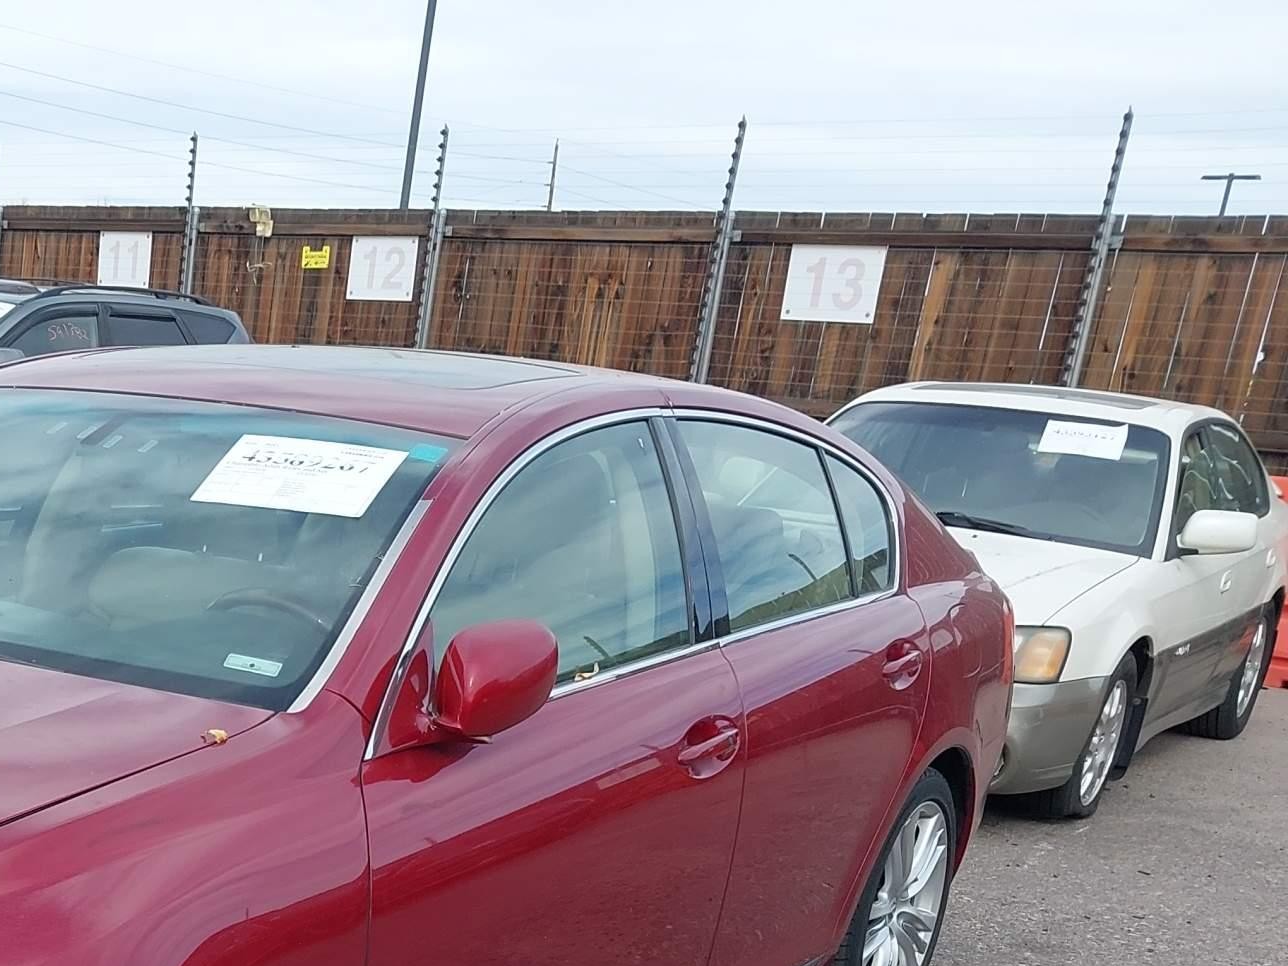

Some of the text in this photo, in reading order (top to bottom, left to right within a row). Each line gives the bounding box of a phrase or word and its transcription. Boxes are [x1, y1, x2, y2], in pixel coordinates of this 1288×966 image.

[109, 240, 139, 281] 11
[363, 245, 406, 290] 12
[806, 257, 866, 311] 13
